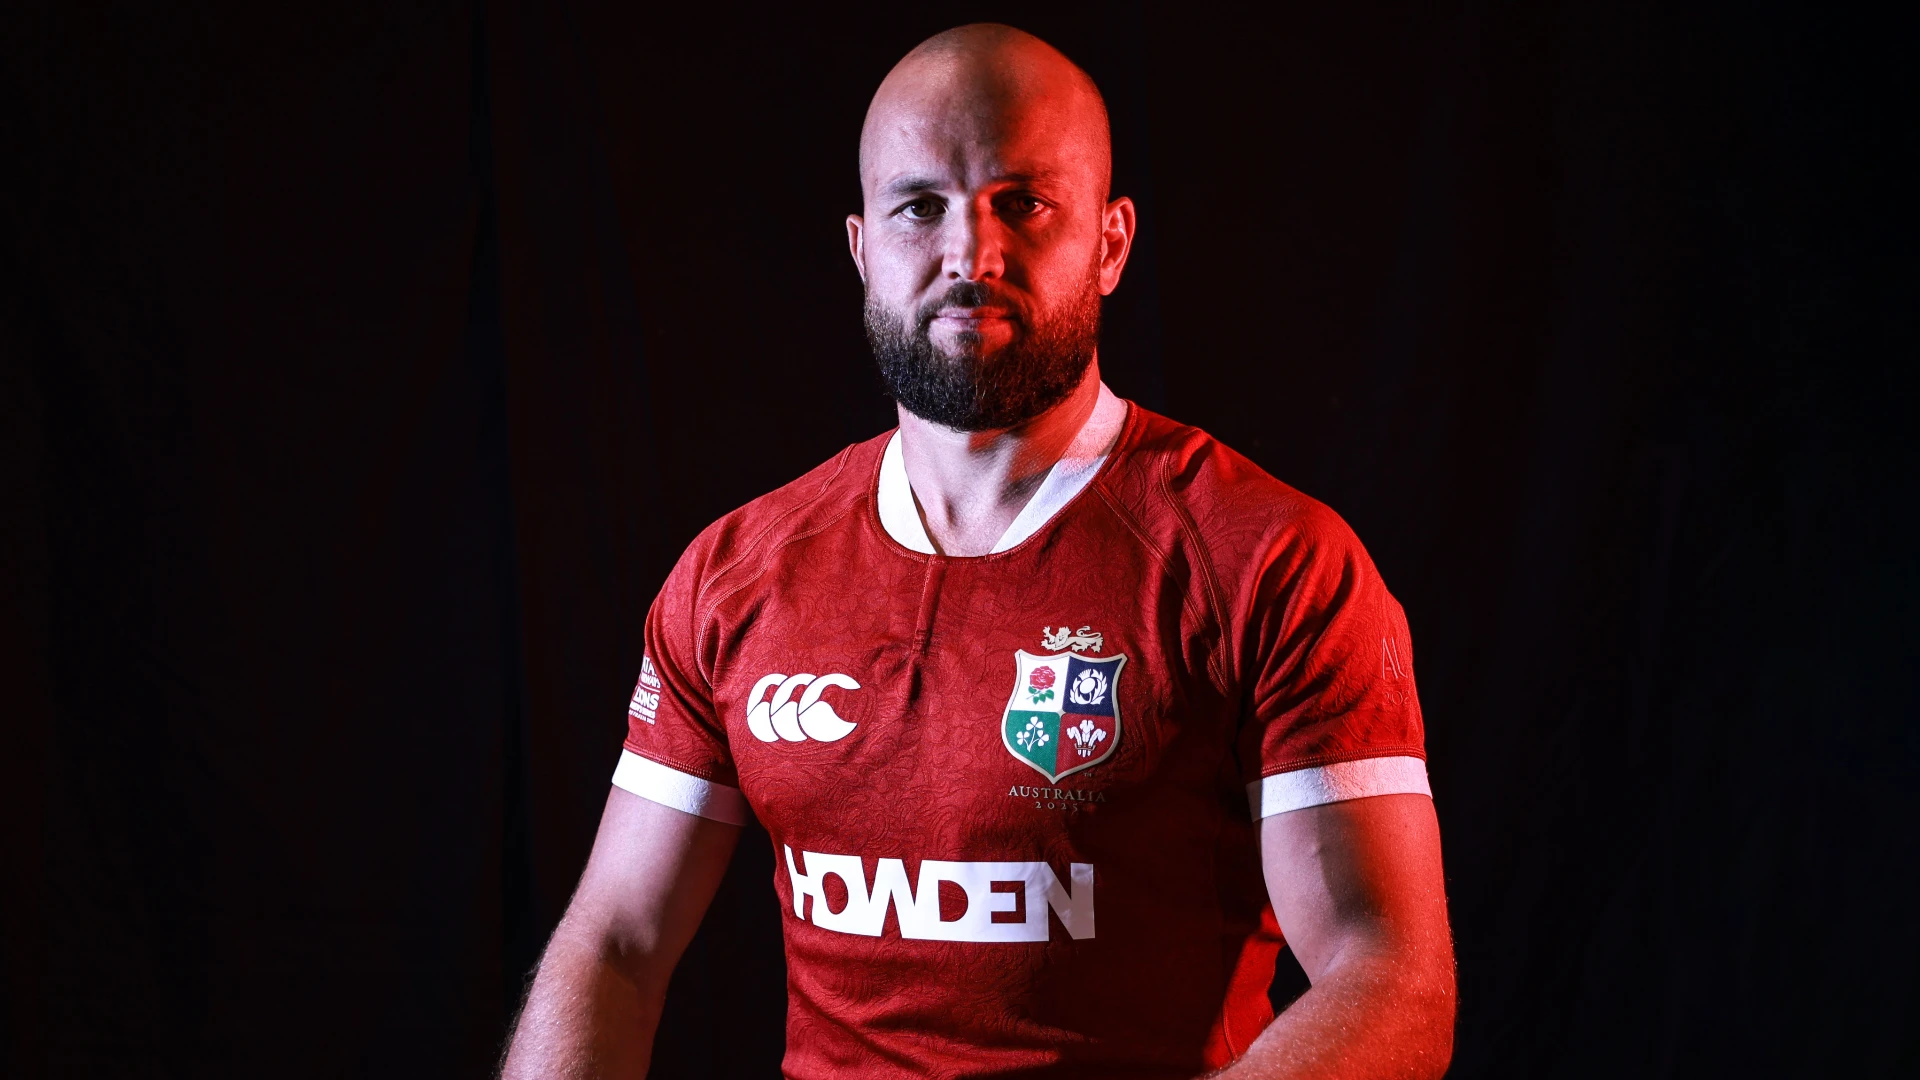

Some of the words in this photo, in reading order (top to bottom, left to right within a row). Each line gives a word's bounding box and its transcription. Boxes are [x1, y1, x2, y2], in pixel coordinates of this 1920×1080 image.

[1008, 785, 1107, 803] AUSTRALIA
[1035, 801, 1078, 814] 2025
[784, 844, 1095, 943] HOWDEN
